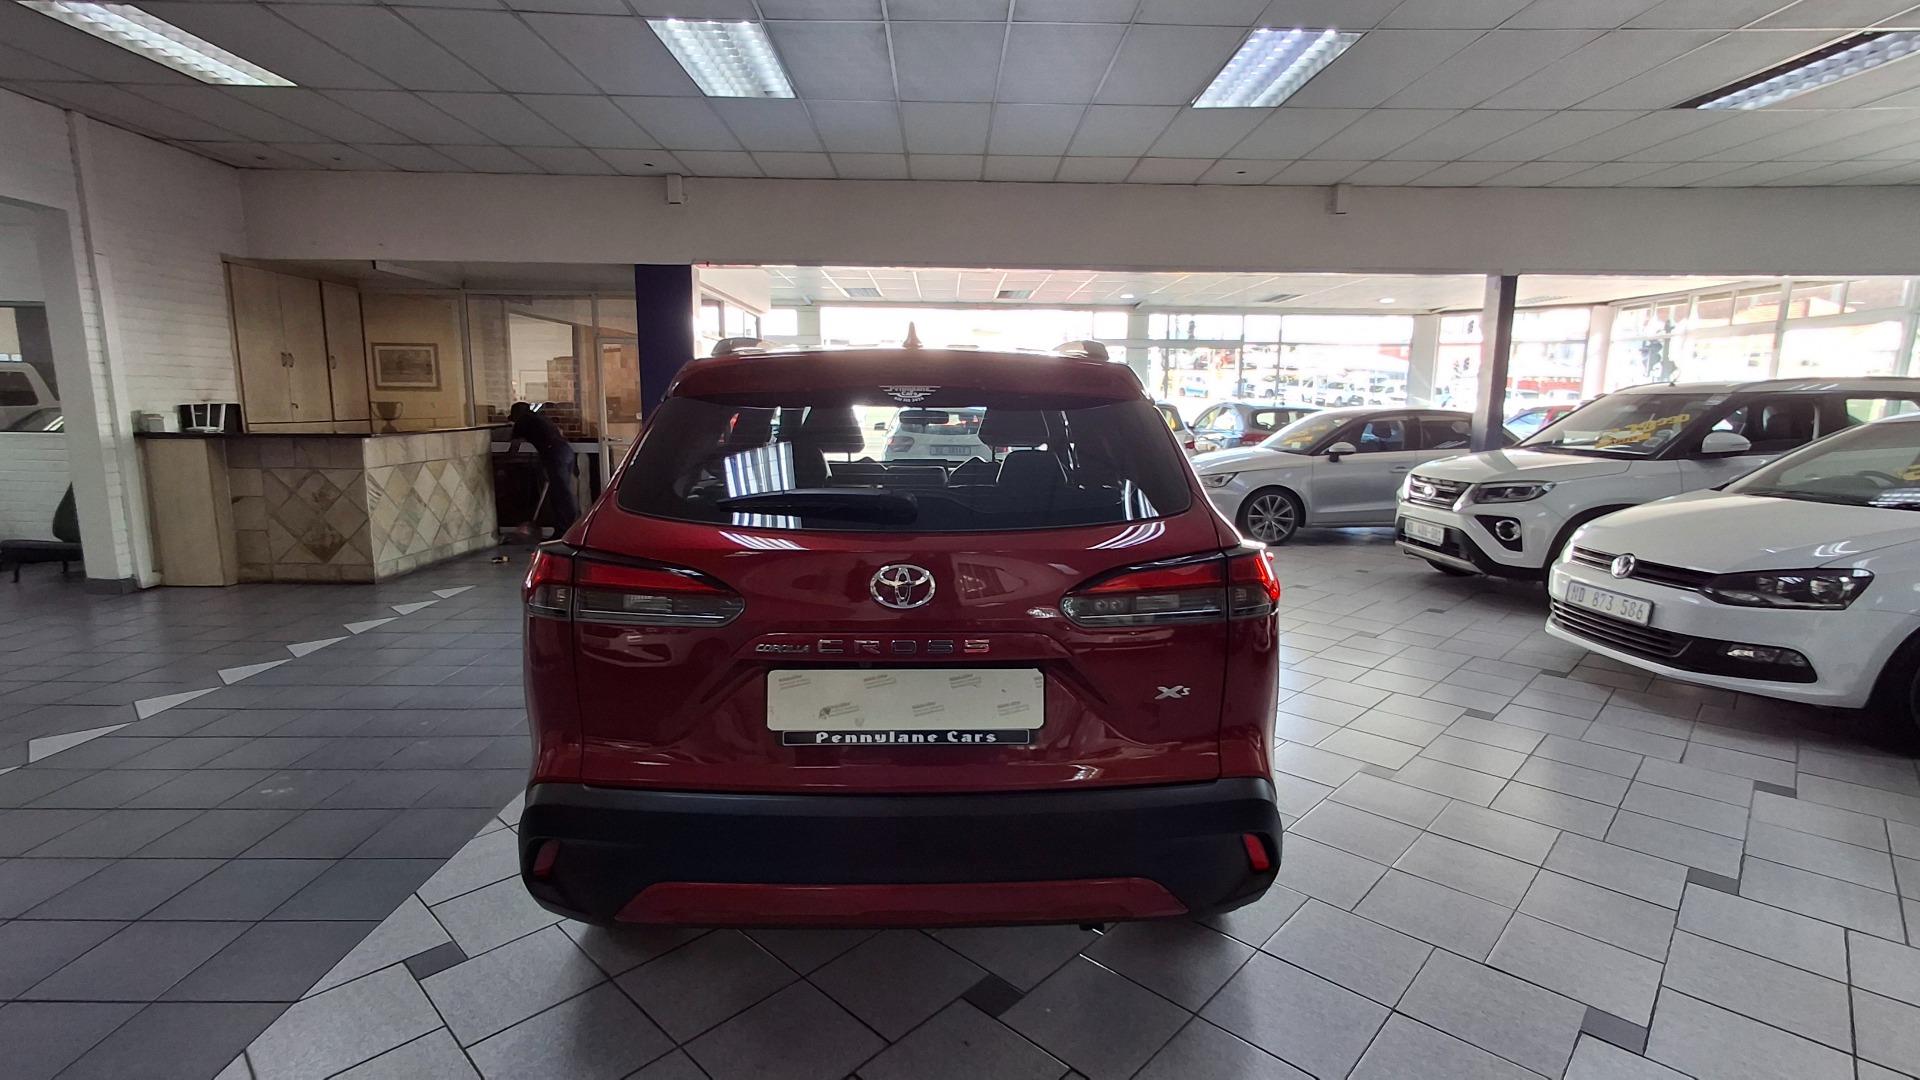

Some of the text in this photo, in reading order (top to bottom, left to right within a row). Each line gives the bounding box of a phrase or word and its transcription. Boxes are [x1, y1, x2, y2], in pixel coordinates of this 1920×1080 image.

[1592, 592, 1613, 611] 873
[1620, 599, 1644, 620] 586
[755, 639, 990, 654] COROLLA CROSS
[816, 731, 997, 744] Pennylane Cars
